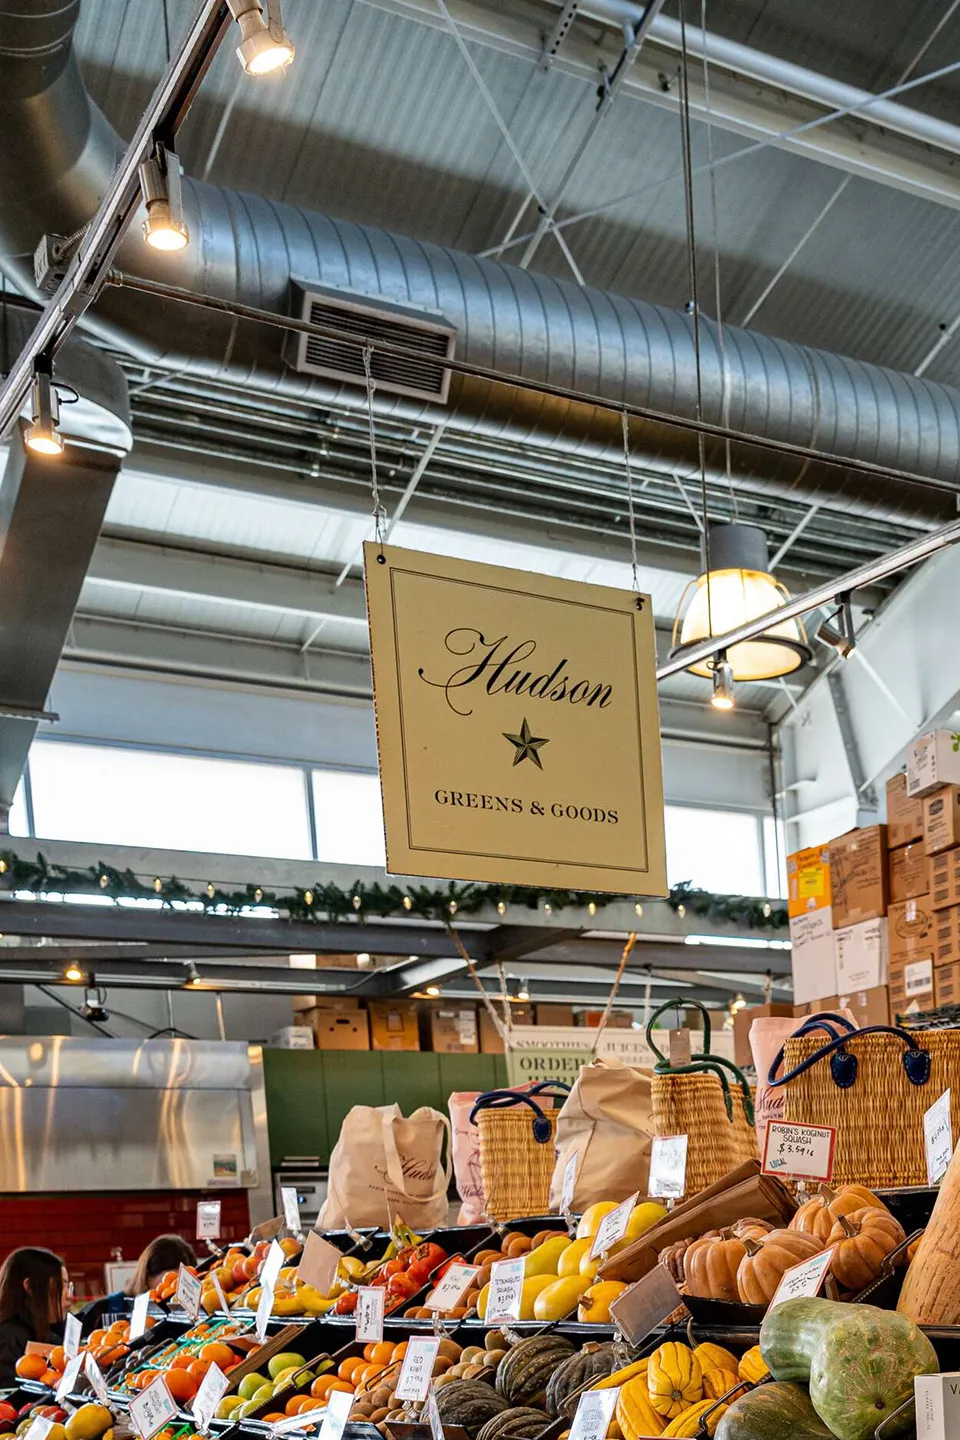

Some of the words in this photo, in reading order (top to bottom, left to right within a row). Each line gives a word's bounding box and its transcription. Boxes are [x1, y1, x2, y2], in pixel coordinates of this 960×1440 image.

[419, 628, 612, 716] Hudson
[434, 789, 523, 813] GREENS
[530, 801, 545, 815] &
[551, 804, 618, 824] GOODS
[772, 1126, 799, 1135] ROBIN'S
[801, 1130, 830, 1138] KOGINUT
[783, 1135, 811, 1145] SQUASH
[770, 1158, 787, 1168] LOCAL
